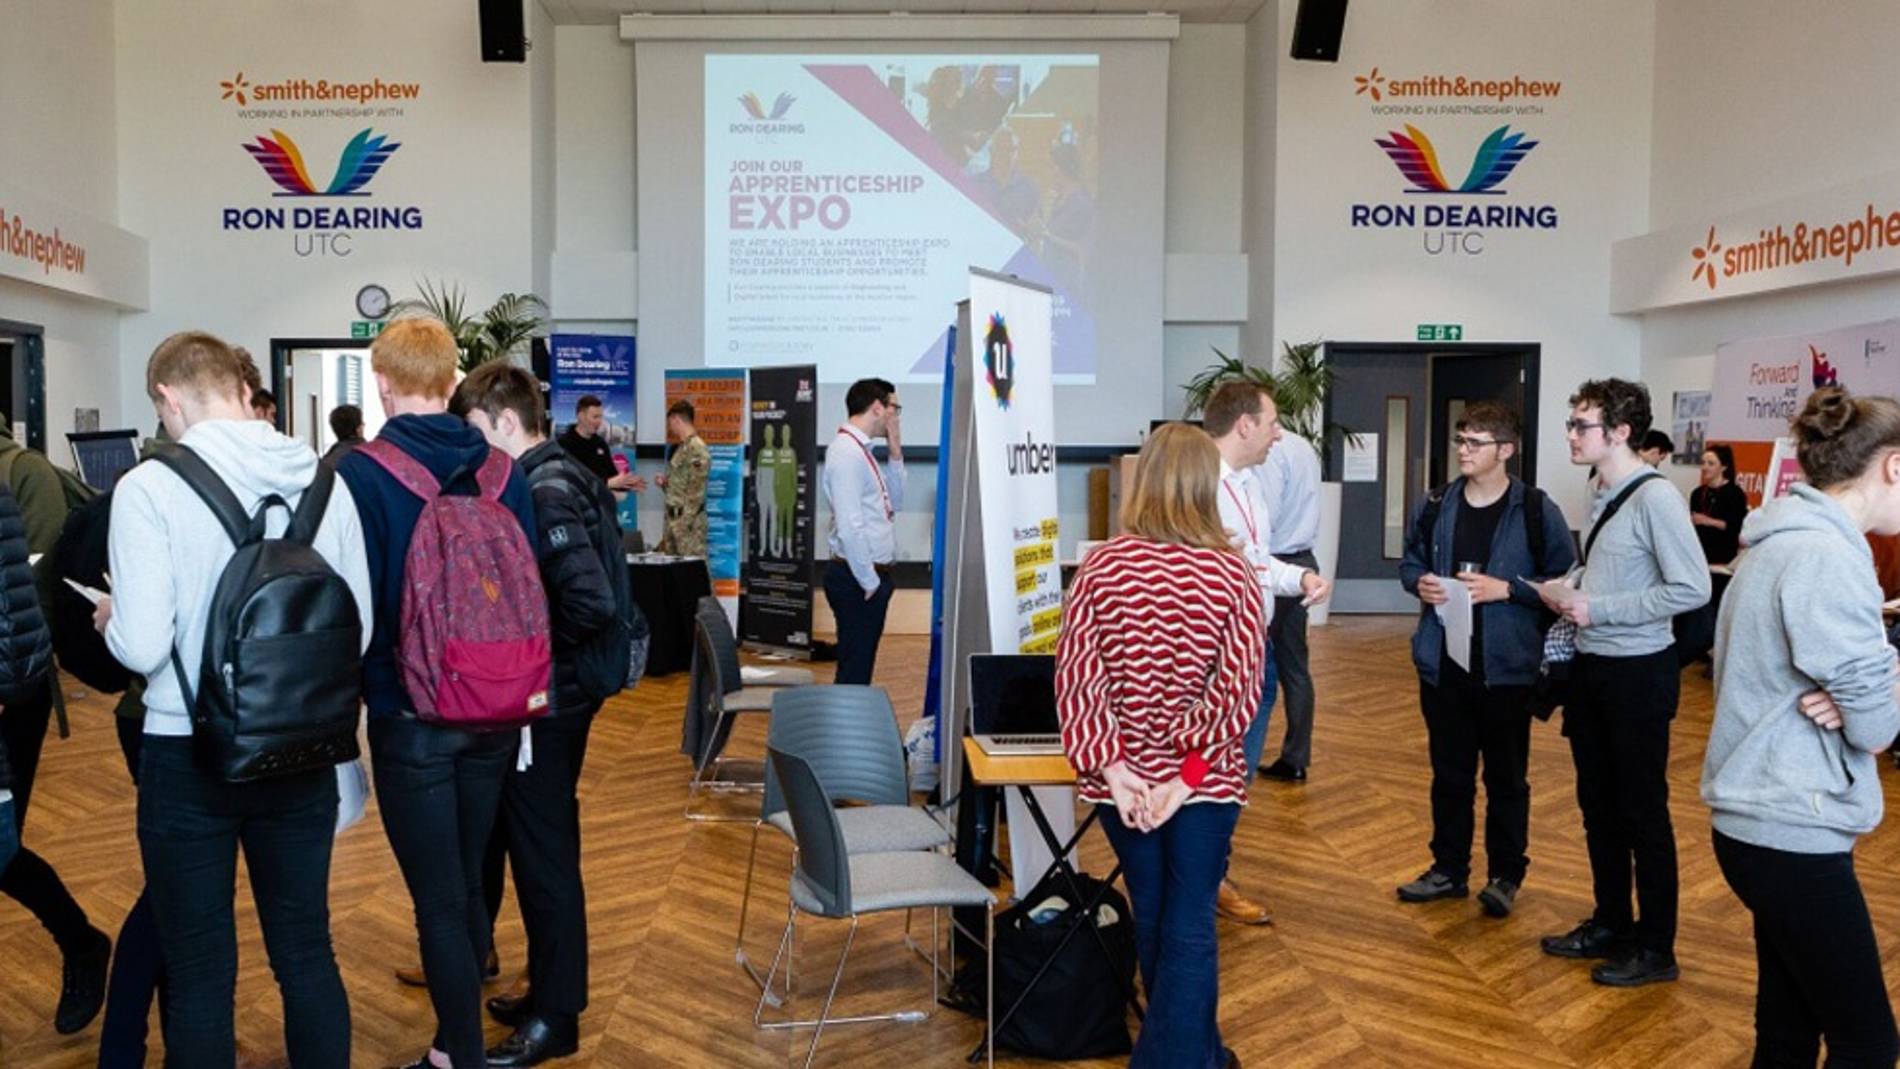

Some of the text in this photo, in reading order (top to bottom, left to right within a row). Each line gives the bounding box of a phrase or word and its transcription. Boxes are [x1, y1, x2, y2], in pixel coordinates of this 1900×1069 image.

[253, 77, 420, 104] smith&nephew
[1388, 76, 1561, 102] smith&nephew
[237, 107, 404, 119] WORKING IN PARTNERSHIP WITH
[1371, 105, 1543, 116] WORKING IN PARTNERSHIP WITH
[729, 123, 806, 135] RON DEARING
[729, 160, 804, 173] JOIN OUR
[729, 175, 925, 193] APPRENTICESHIP
[223, 206, 423, 230] RON DEARING
[729, 194, 852, 231] EXPO
[1351, 205, 1558, 229] RON DEARING
[294, 233, 353, 257] UTC
[1423, 232, 1484, 255] UTC
[1007, 431, 1054, 476] umber
